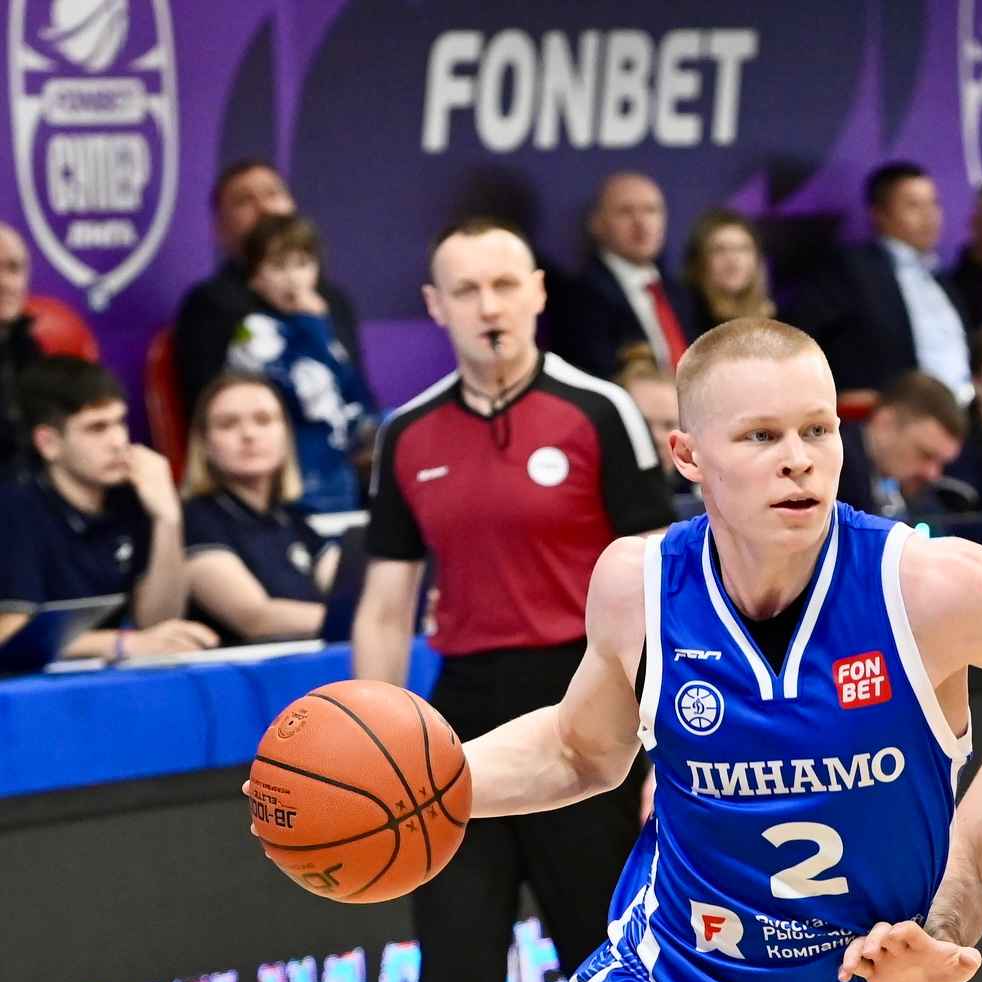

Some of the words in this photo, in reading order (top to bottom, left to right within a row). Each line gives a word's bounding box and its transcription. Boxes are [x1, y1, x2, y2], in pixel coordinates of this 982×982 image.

[420, 28, 760, 153] FONBET
[837, 657, 881, 684] FON
[841, 677, 885, 704] BET
[686, 746, 905, 798] ДИНАМО
[762, 821, 849, 899] 2
[766, 936, 856, 959] Компани
